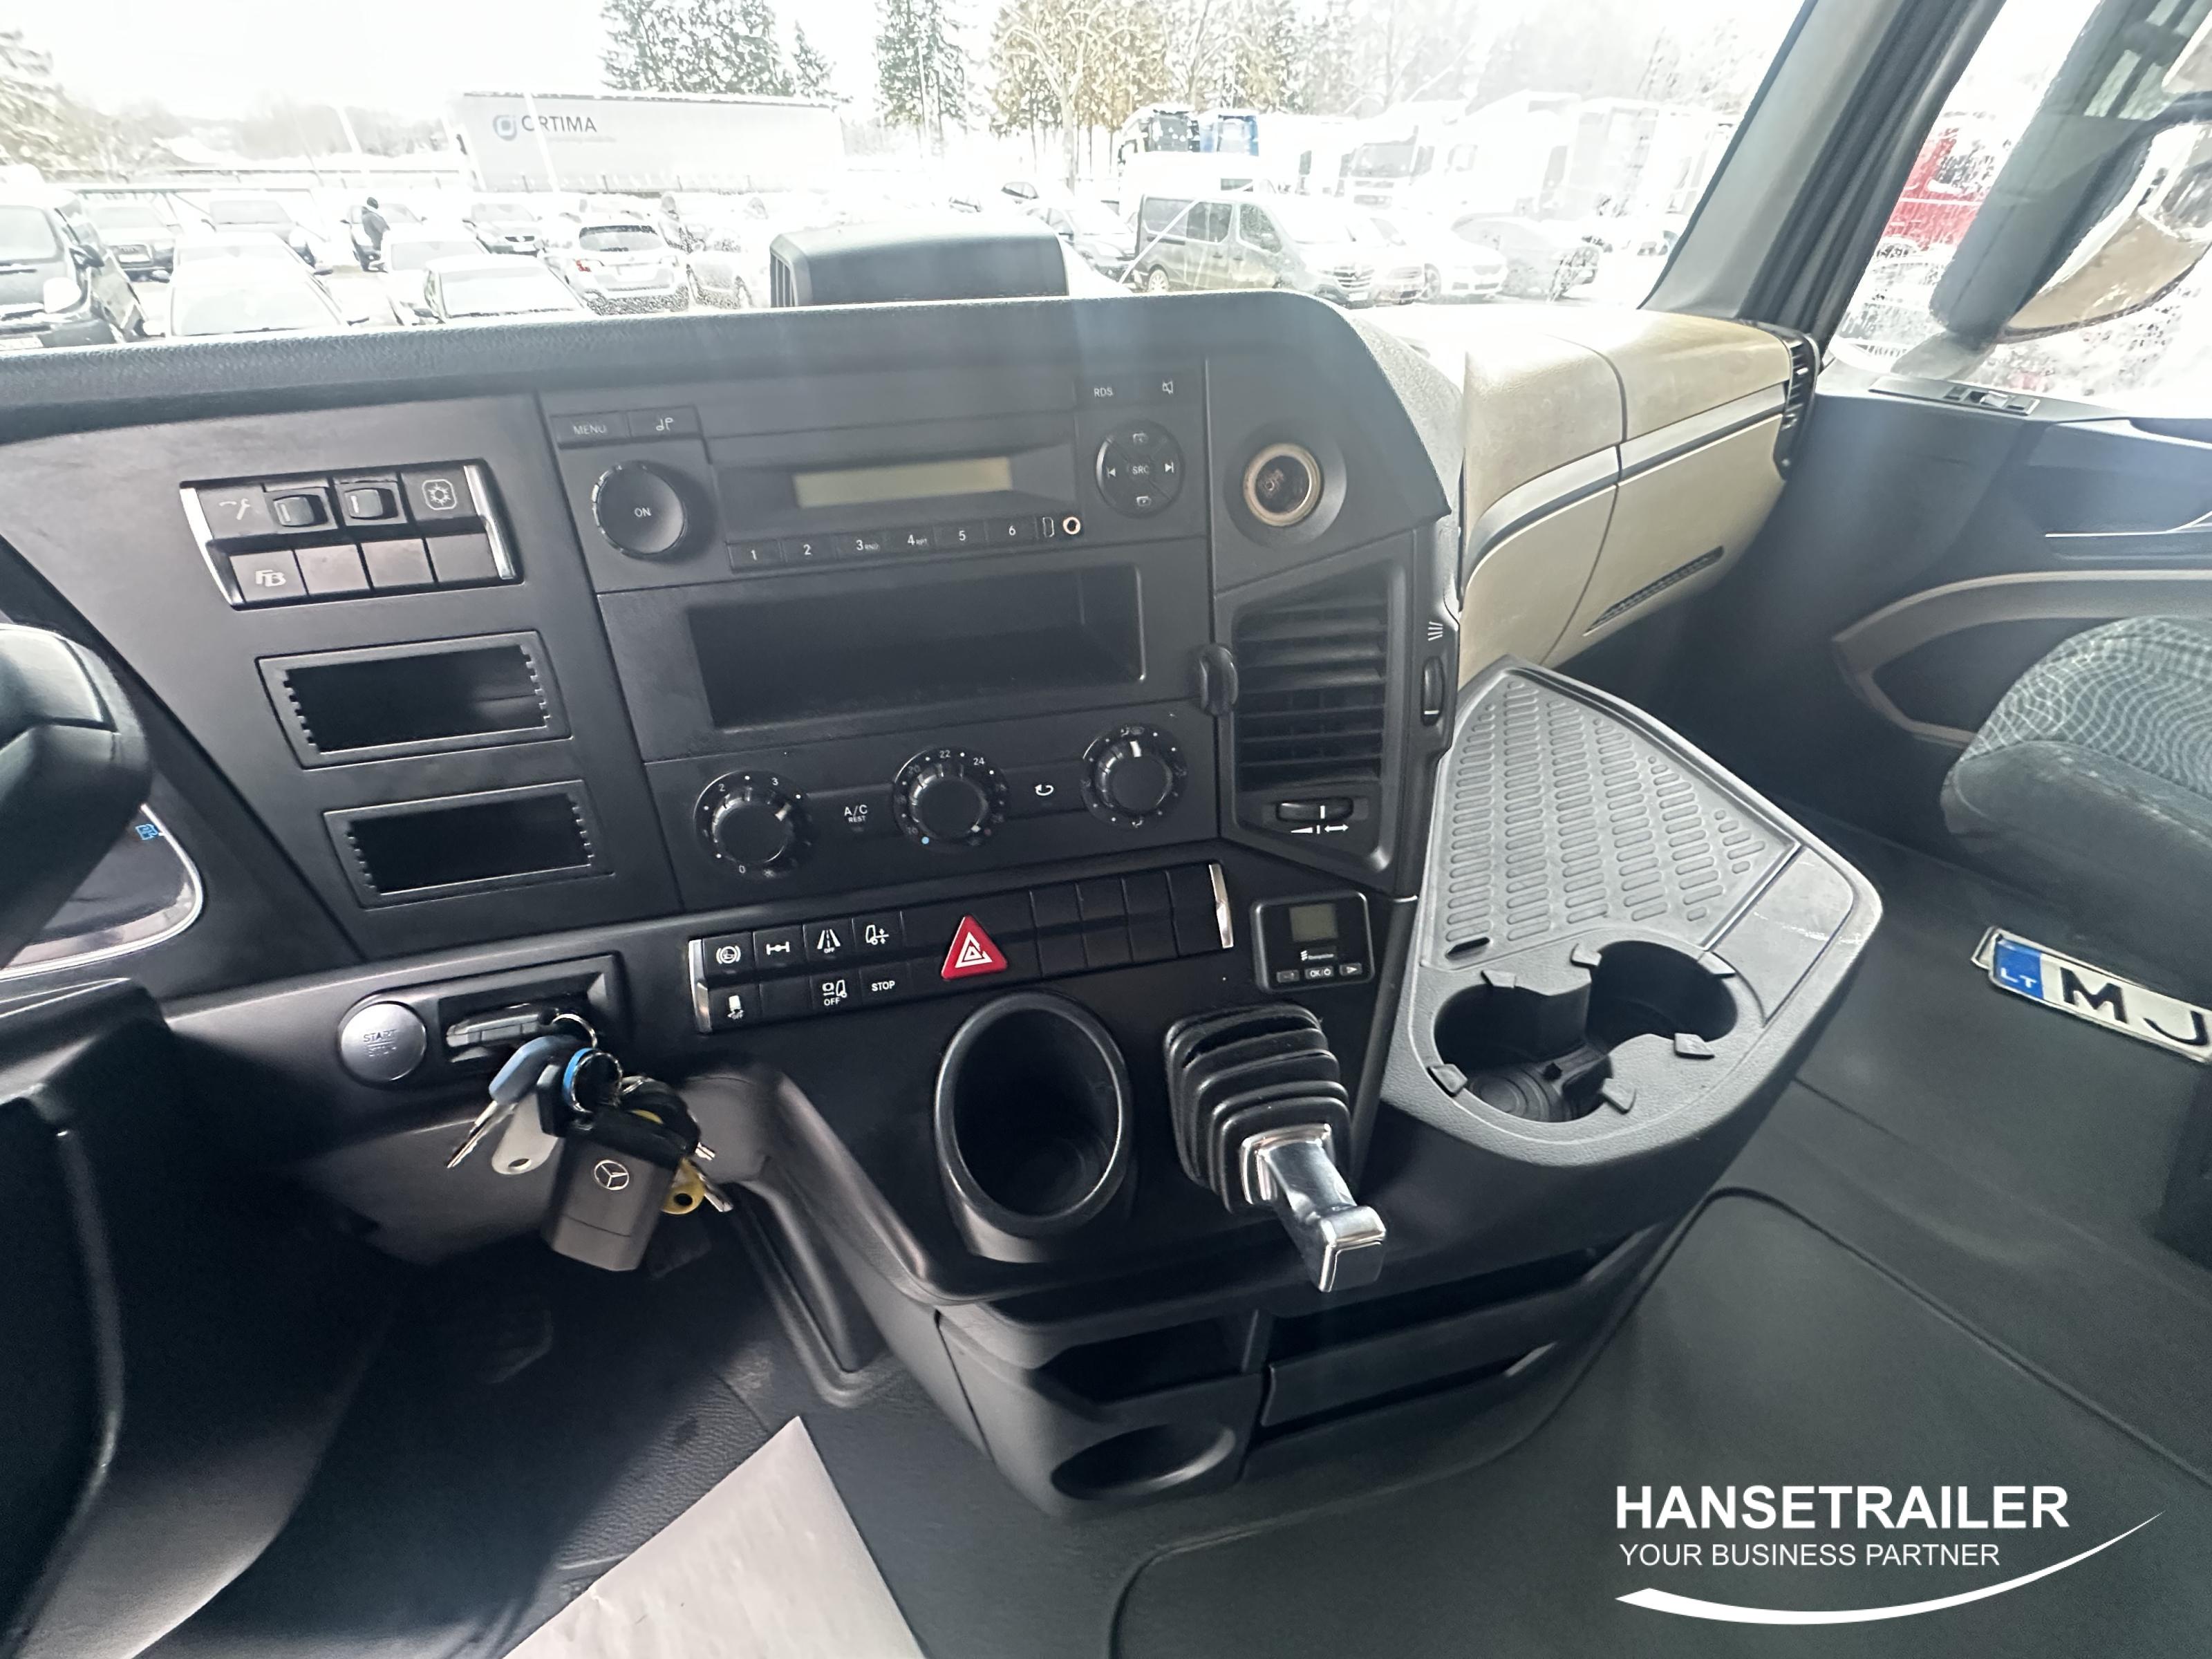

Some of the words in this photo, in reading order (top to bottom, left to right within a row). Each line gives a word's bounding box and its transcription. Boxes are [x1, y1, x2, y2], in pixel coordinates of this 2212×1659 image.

[1094, 387, 1114, 397] RDS
[573, 424, 606, 435] MENU
[1132, 465, 1150, 475] SRC
[635, 507, 652, 518] ON
[958, 530, 966, 541] 5
[1009, 525, 1016, 536] 6
[856, 539, 863, 550] 3
[908, 534, 915, 545] 4
[751, 549, 758, 561] 1
[803, 544, 812, 556] 2
[939, 749, 950, 758] 22
[973, 757, 985, 766] 24
[771, 777, 778, 786] 3
[718, 783, 726, 792] 2
[844, 805, 868, 816] A/C
[739, 865, 747, 874] 0
[2000, 967, 2037, 988] LT
[871, 980, 896, 991] STOP
[823, 997, 841, 1006] OFF
[363, 1029, 397, 1042] START
